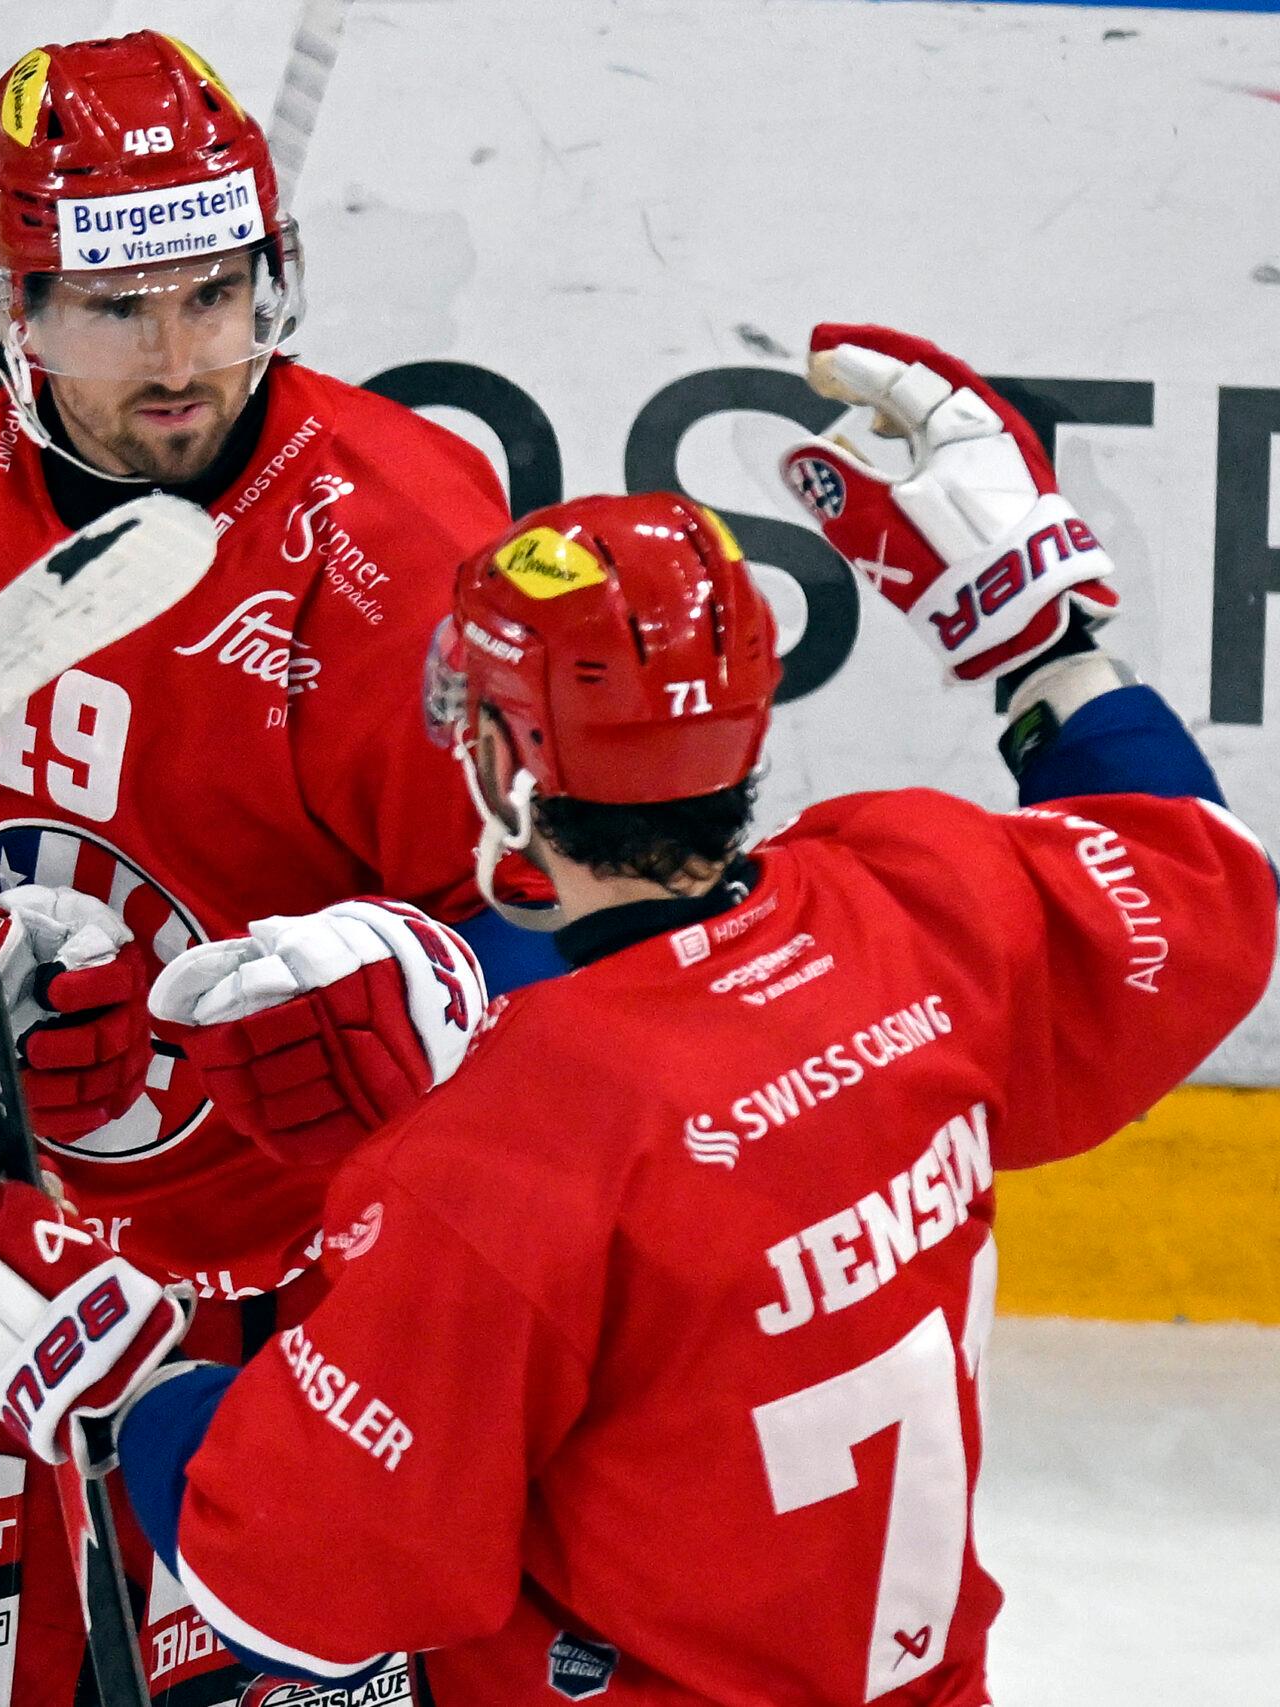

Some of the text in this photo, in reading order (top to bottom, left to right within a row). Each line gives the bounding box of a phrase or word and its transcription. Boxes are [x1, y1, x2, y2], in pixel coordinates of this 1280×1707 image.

[124, 126, 174, 156] 49
[74, 183, 250, 236] Burgerstein
[122, 231, 218, 262] Vitamine
[233, 415, 324, 514] HOSTPOINT
[928, 517, 1103, 651] AUER
[664, 679, 714, 718] 71
[732, 994, 953, 1142] SWISS CASING
